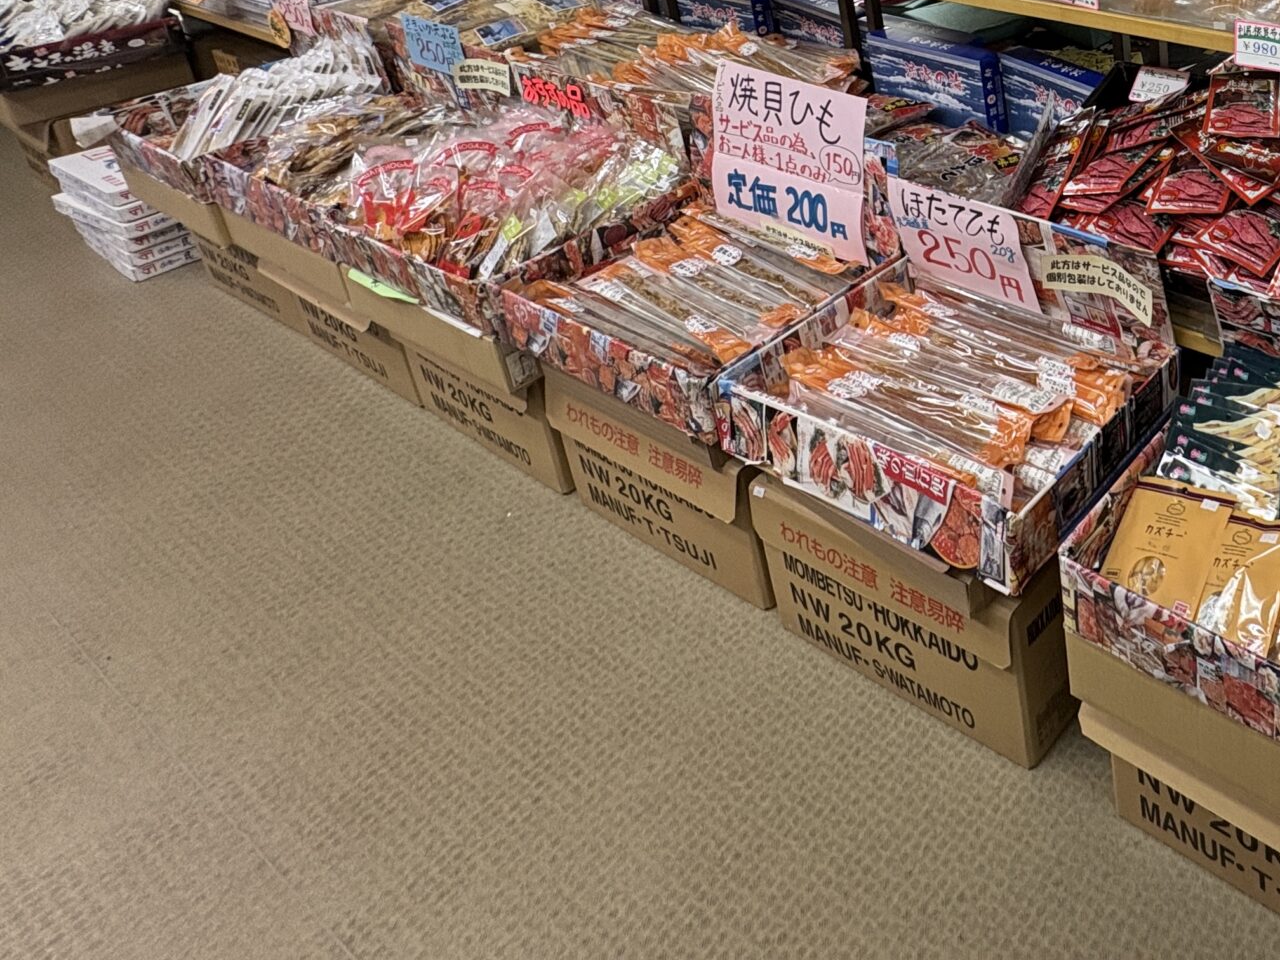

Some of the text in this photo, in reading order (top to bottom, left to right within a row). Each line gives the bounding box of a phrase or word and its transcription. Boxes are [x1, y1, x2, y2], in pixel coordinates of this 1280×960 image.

[1242, 40, 1278, 57] ¥980
[522, 75, 591, 120] おすすめ品
[728, 73, 841, 145] 焼貝ひも
[1139, 81, 1171, 94] ¥250
[718, 114, 816, 160] サービス品の為、
[825, 151, 860, 181] 150円
[728, 168, 848, 241] 定価 200円
[901, 188, 1005, 247] ほたてひも
[918, 229, 1025, 304] 250円
[1051, 259, 1146, 300] 此方はサービス品なので
[1046, 273, 1149, 317] 個別包装はしておりません
[419, 363, 446, 395] NW
[447, 380, 493, 424] 20KG
[566, 401, 641, 457] われもの注意
[579, 453, 612, 488] NW
[615, 467, 674, 524] 20KG
[1145, 524, 1188, 539] カズチー
[779, 520, 967, 635] われもの注意 注意易碎
[790, 581, 918, 672] NW 20KG
